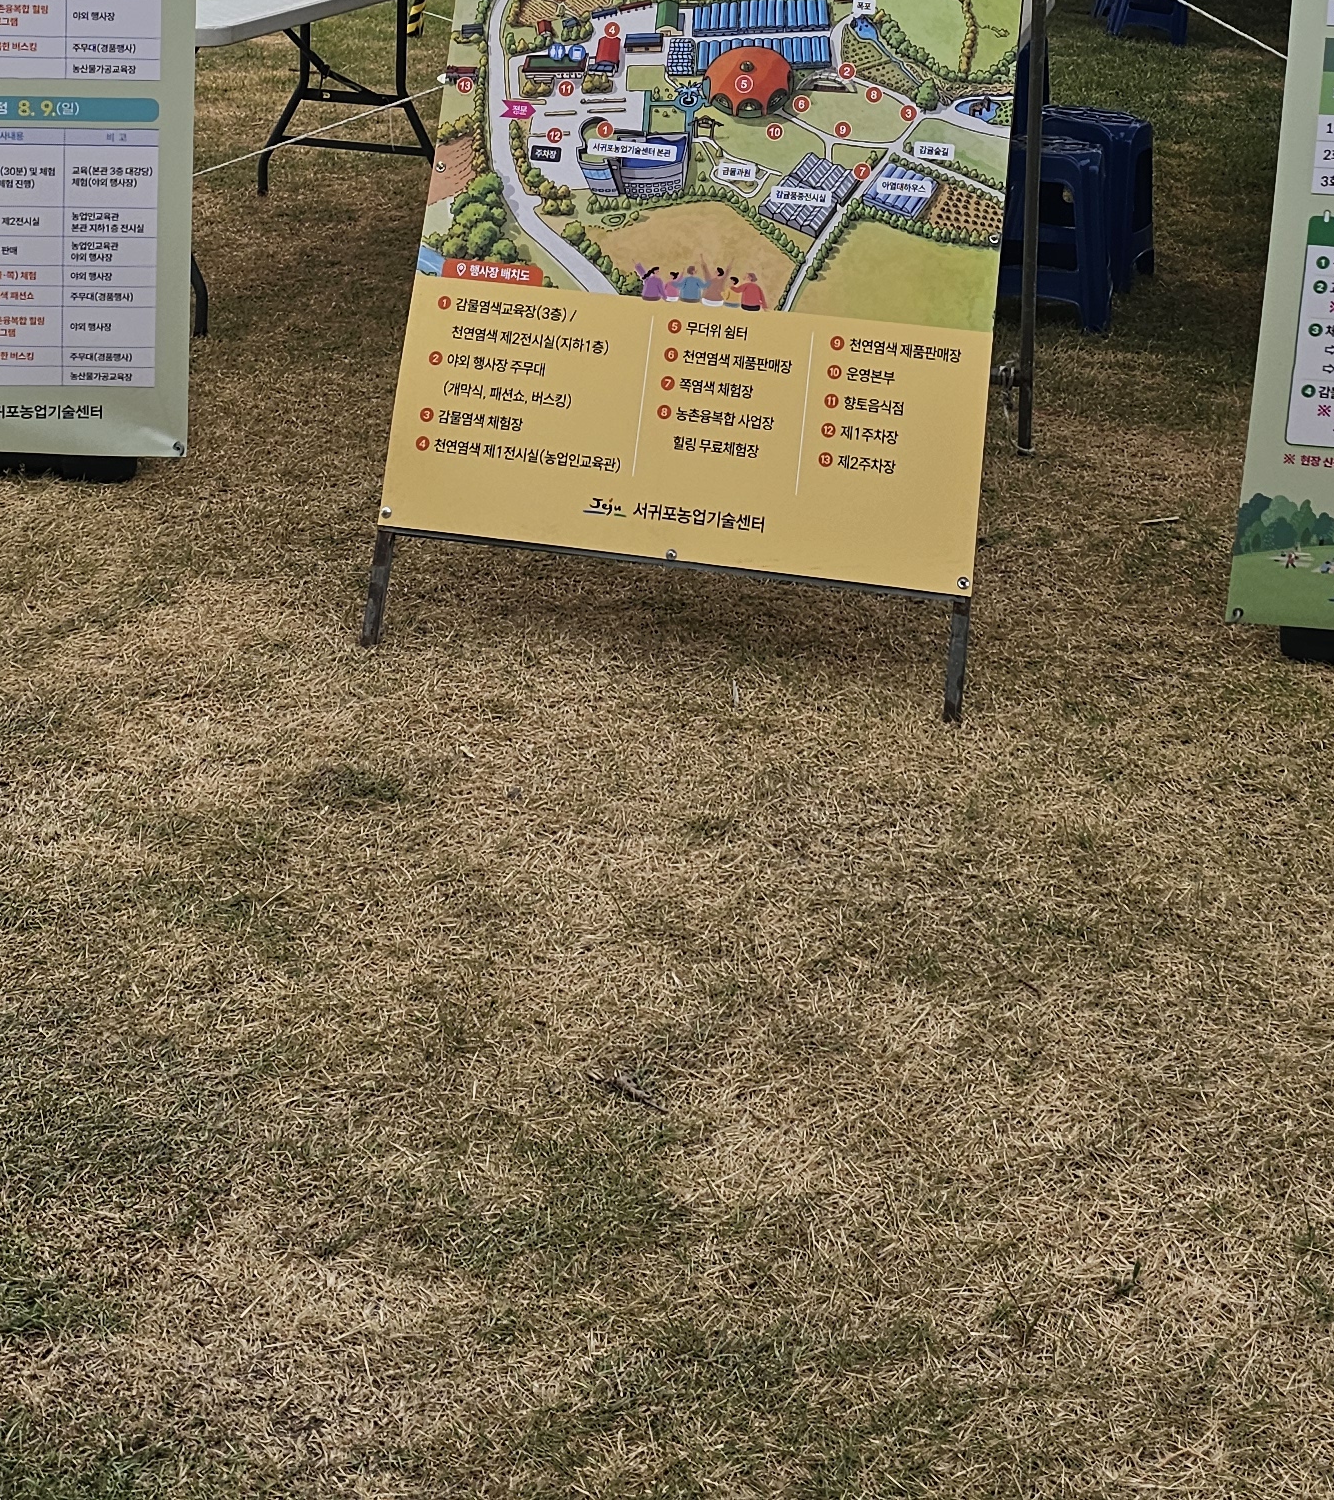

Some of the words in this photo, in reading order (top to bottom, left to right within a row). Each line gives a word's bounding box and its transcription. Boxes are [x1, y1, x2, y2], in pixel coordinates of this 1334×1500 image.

[534, 149, 557, 159] 주차장
[470, 266, 499, 280] 행사장
[500, 269, 530, 282] 배치도
[455, 298, 567, 322] 감물염색교육장(3층)
[451, 326, 498, 342] 천연염색
[500, 331, 609, 355] 제2전시실(지하1층)
[686, 322, 721, 338] 무더위
[724, 326, 748, 341] 쉼터
[447, 354, 470, 369] 야외
[473, 357, 508, 372] 행사장
[510, 360, 545, 377] 주무대
[846, 367, 895, 385] 운영본부
[843, 396, 904, 416] 향토음식점
